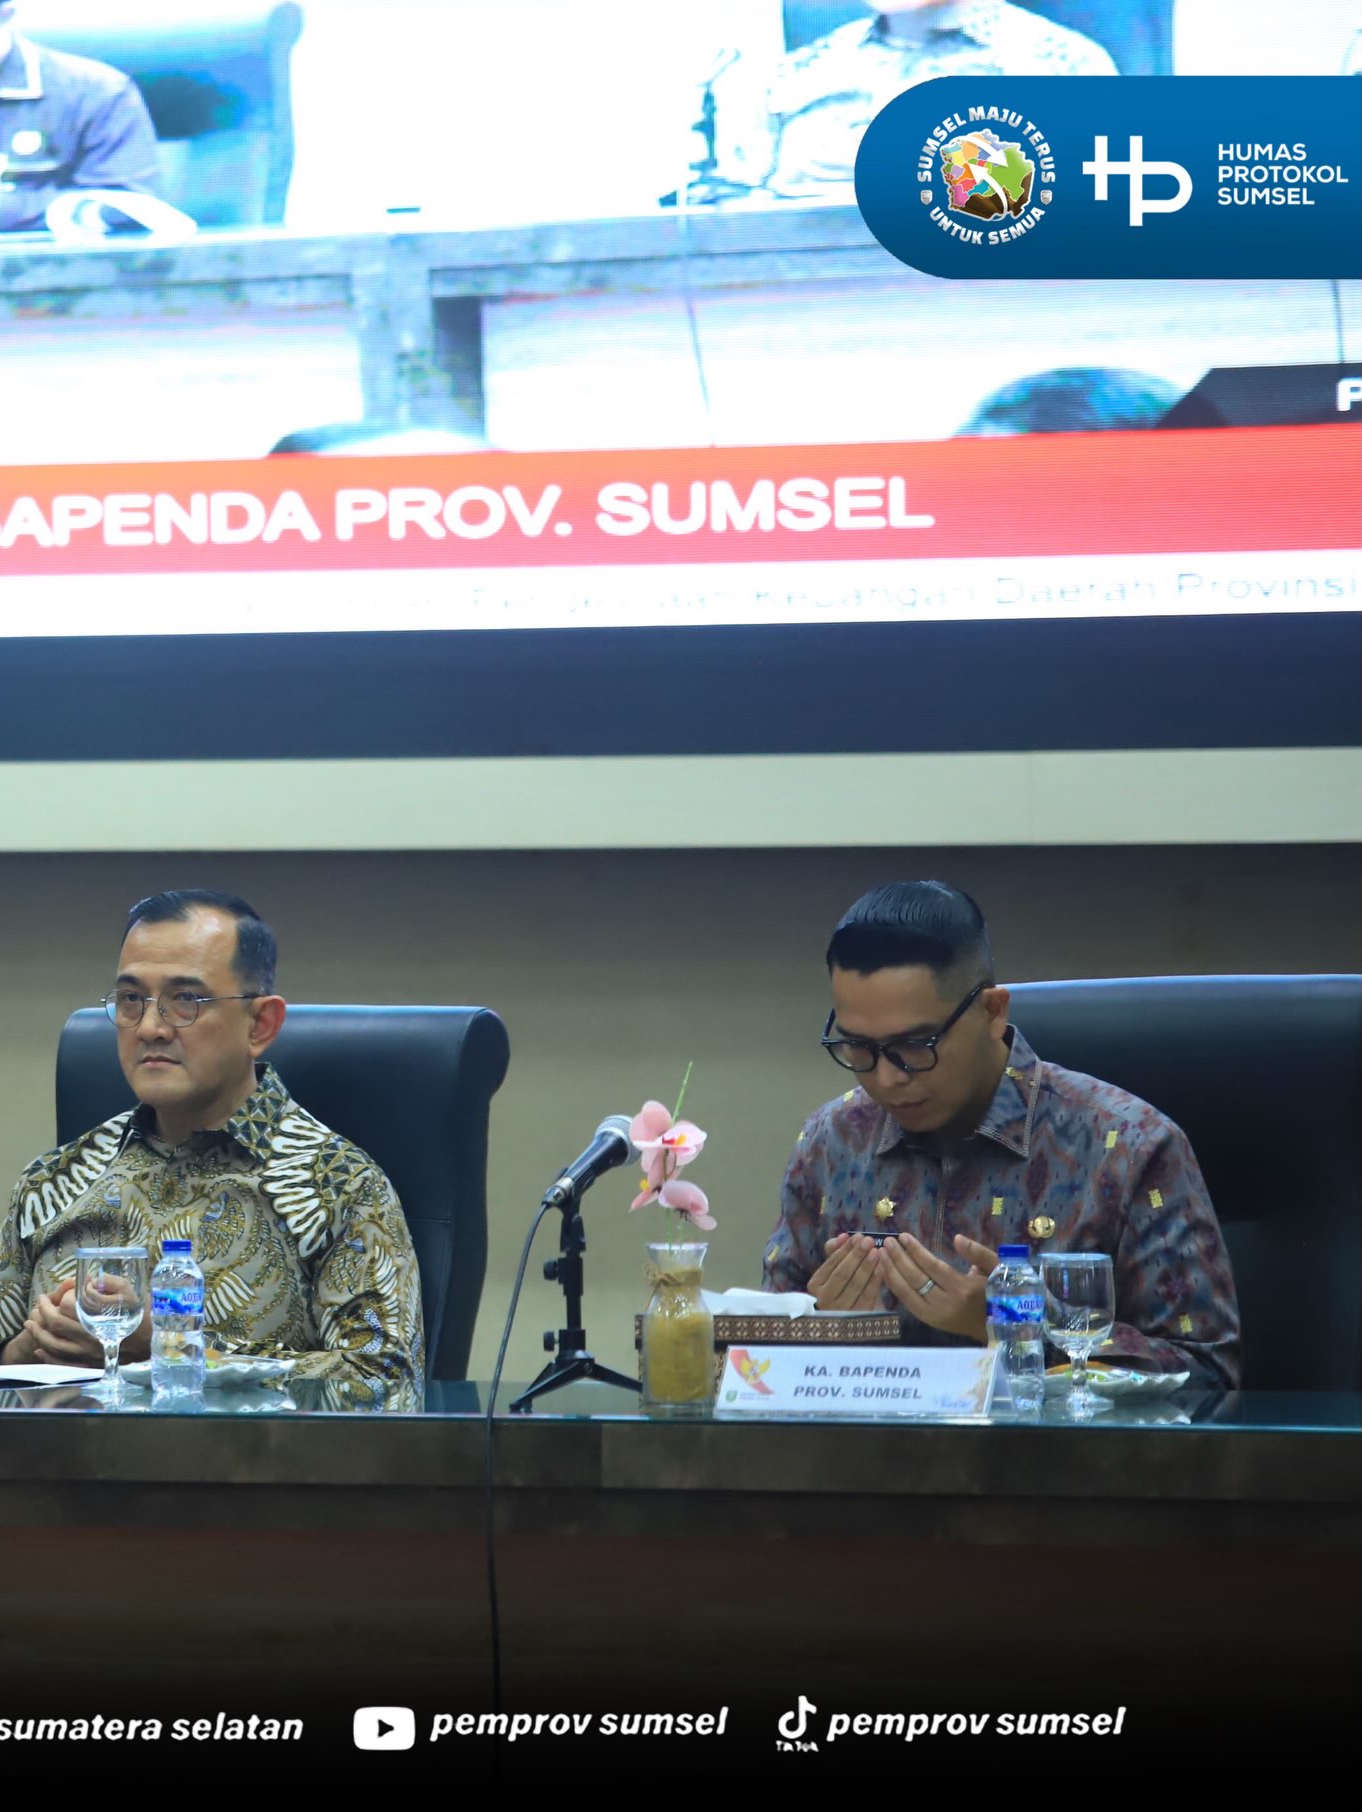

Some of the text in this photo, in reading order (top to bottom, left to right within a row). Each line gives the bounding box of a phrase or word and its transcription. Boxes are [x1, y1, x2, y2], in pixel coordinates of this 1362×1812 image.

[335, 485, 573, 541] PROV.
[595, 476, 935, 537] SUMSEL
[804, 1365, 921, 1379] KA. BAPENDA
[794, 1386, 922, 1399] PROV. SUMSEL
